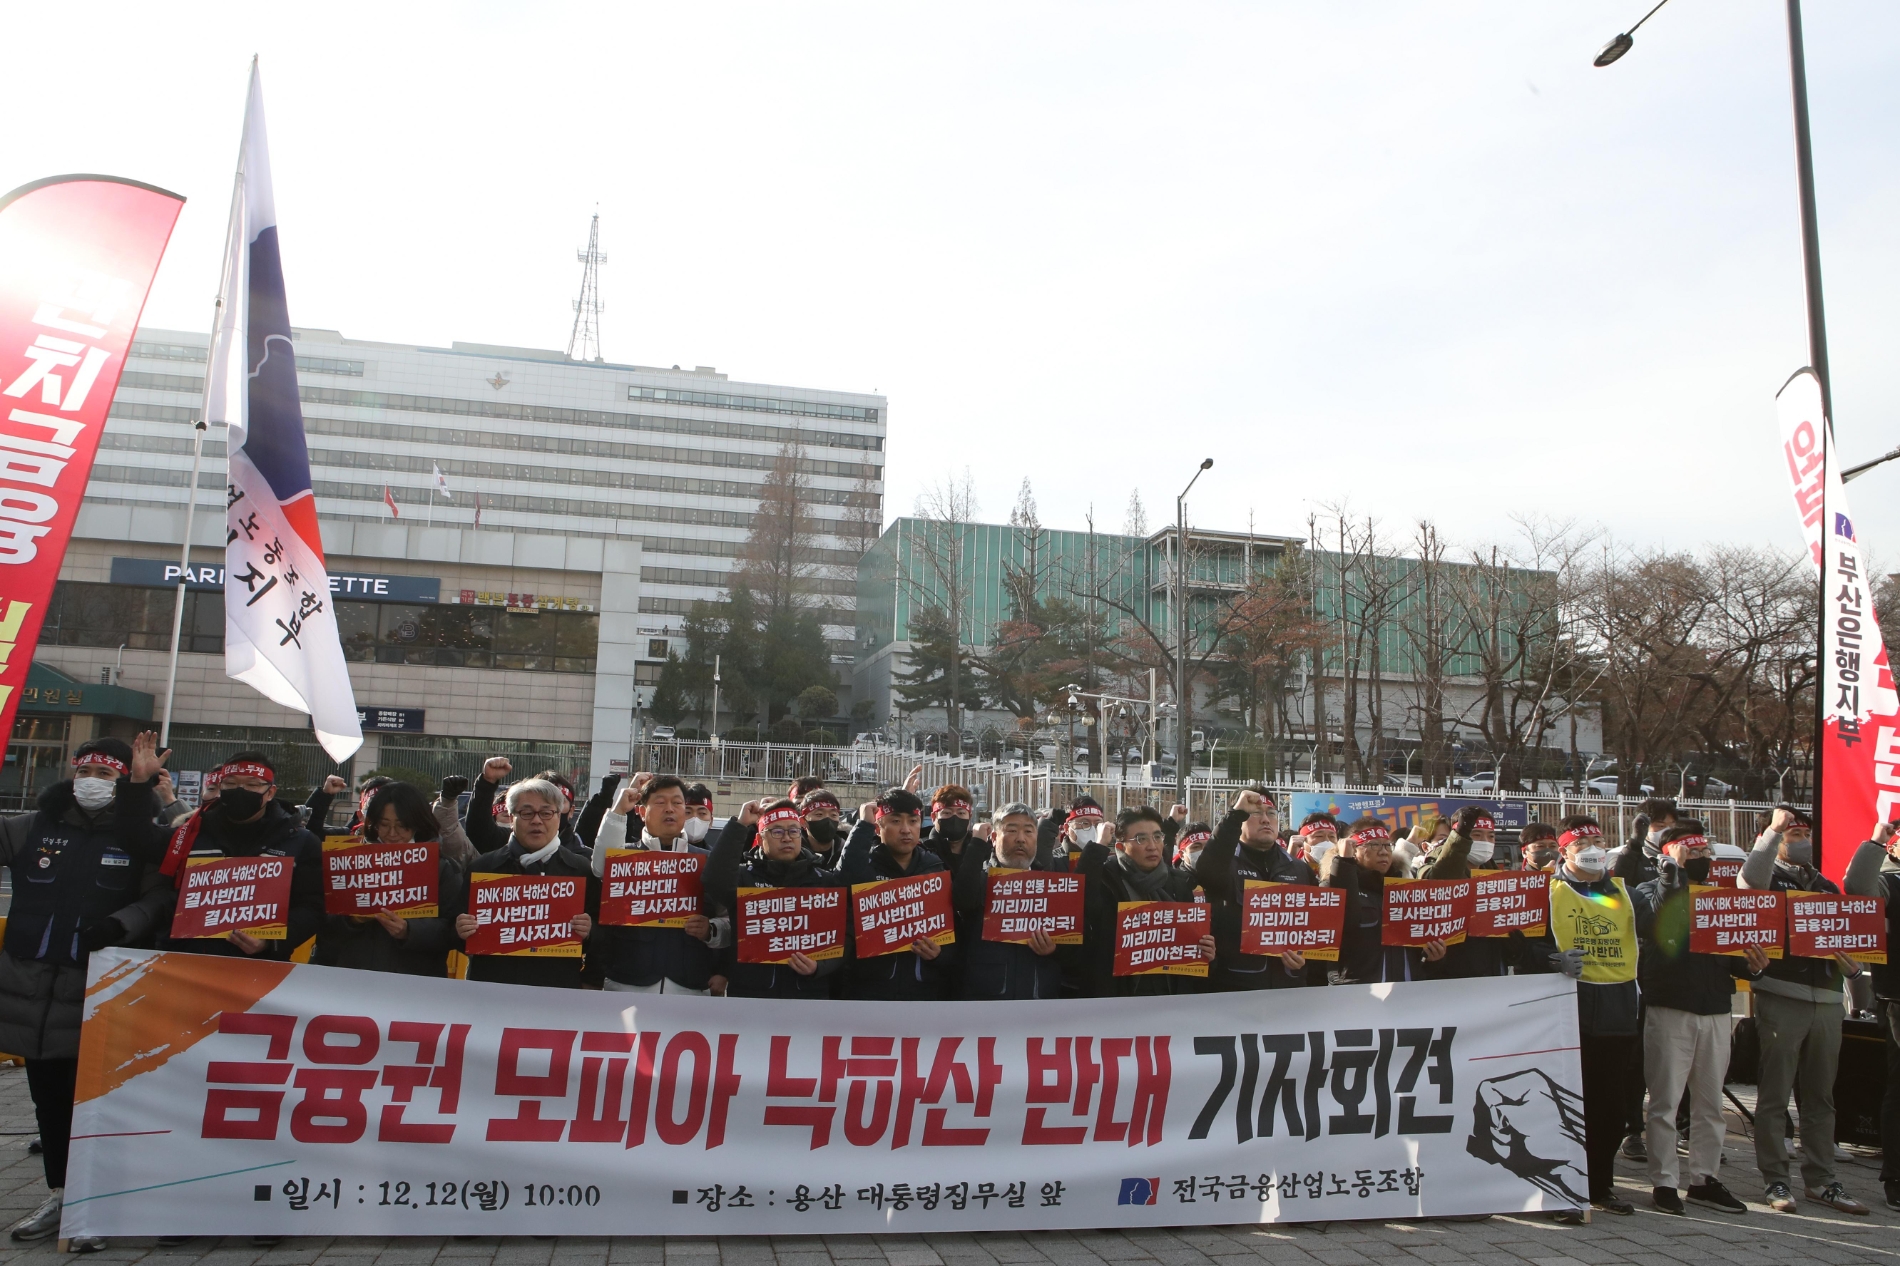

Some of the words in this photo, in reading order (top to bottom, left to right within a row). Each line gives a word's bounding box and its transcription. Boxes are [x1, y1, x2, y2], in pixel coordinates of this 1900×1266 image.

[164, 565, 224, 583] PARI
[1835, 551, 1863, 749] 부산은행지부
[22, 686, 83, 705] 민원실
[105, 754, 124, 770] 투쟁
[245, 764, 265, 777] 투쟁
[1075, 808, 1091, 816] 단결
[1189, 831, 1205, 842] 단결
[1358, 828, 1376, 840] 단결
[1571, 825, 1589, 837] 단결
[329, 854, 373, 871] BNK·IBK
[374, 850, 402, 869] 낙하산
[403, 846, 428, 864] CEO
[610, 861, 651, 878] BNK·IBK
[653, 859, 677, 875] 낙하산
[678, 857, 698, 874] CEO
[188, 866, 231, 888] BNK·IBK
[231, 863, 258, 882] 낙하산
[258, 861, 283, 879] CEO
[330, 869, 403, 891] 결사반대!
[1712, 864, 1739, 877] 낙하산
[475, 886, 520, 904] BNK·IBK
[522, 882, 550, 901] 낙하산
[551, 880, 575, 898] CEO
[609, 878, 677, 899] 결사반대!
[859, 888, 897, 912] BNK·IBK
[898, 881, 922, 900] 낙하산
[922, 876, 943, 895] CEO
[992, 879, 1023, 895] 수십억
[1025, 878, 1044, 894] 연봉
[1047, 877, 1079, 893] 노리는
[1389, 887, 1427, 904] BNK·IBK
[1429, 885, 1452, 902] 낙하산
[1453, 881, 1470, 898] CEO
[1475, 878, 1518, 895] 함량미달
[1519, 874, 1546, 891] 낙하산
[184, 884, 255, 909] 결사반대!
[355, 885, 428, 908] 결사저지!
[630, 896, 697, 916] 결사저지!
[745, 894, 797, 916] 함량미달
[800, 891, 839, 910] 낙하산
[990, 897, 1047, 914] 끼리끼리
[1249, 894, 1282, 910] 수십억
[1284, 892, 1305, 908] 연봉
[1308, 891, 1341, 908] 노리는
[1475, 894, 1526, 913] 금융위기
[1695, 896, 1732, 912] BNK·IBK
[1733, 896, 1757, 911] 낙하산
[1757, 894, 1777, 909] CEO
[204, 903, 278, 927] 결사저지!
[475, 903, 549, 926] 결사반대!
[860, 901, 925, 931] 결사반대!
[1122, 911, 1151, 930] 수십억
[1153, 909, 1174, 927] 연봉
[1176, 906, 1206, 924] 노리는
[1389, 903, 1452, 921] 결사반대!
[1493, 908, 1542, 928] 초래한다!
[1793, 901, 1838, 916] 함량미달
[1841, 899, 1878, 914] 낙하산
[745, 915, 809, 936] 금융위기
[883, 913, 946, 944] 결사저지!
[1000, 916, 1075, 934] 모피아천국!
[1249, 911, 1309, 927] 끼리끼리
[1409, 916, 1466, 938] 결사저지!
[1695, 912, 1757, 929] 결사반대!
[1794, 917, 1850, 933] 금융위기
[499, 921, 573, 945] 결사저지!
[768, 929, 837, 953] 초래한다!
[1121, 927, 1176, 949] 끼리끼리
[1260, 928, 1335, 947] 모피아천국!
[1573, 936, 1597, 945] 산업은행
[1597, 938, 1621, 946] 지방이전
[1716, 929, 1777, 946] 결사저지!
[1814, 933, 1878, 950] 초래한다!
[1130, 944, 1202, 967] 모피아천국!
[200, 1011, 472, 1144] 금융권
[485, 1027, 741, 1151] 모피아
[763, 1035, 1003, 1151] 낙하산
[1022, 1035, 1173, 1148] 반대
[1187, 1026, 1458, 1145] 기자회견
[281, 1178, 341, 1212] 일시
[377, 1181, 511, 1212] 12.12(월)
[524, 1183, 601, 1208] 10:00
[1172, 1166, 1425, 1204] 전국금융산업노동조합
[696, 1184, 755, 1212] 장소
[785, 1183, 846, 1212] 용산
[857, 1181, 1027, 1212] 대통령집무실
[1040, 1181, 1066, 1208] 앞
